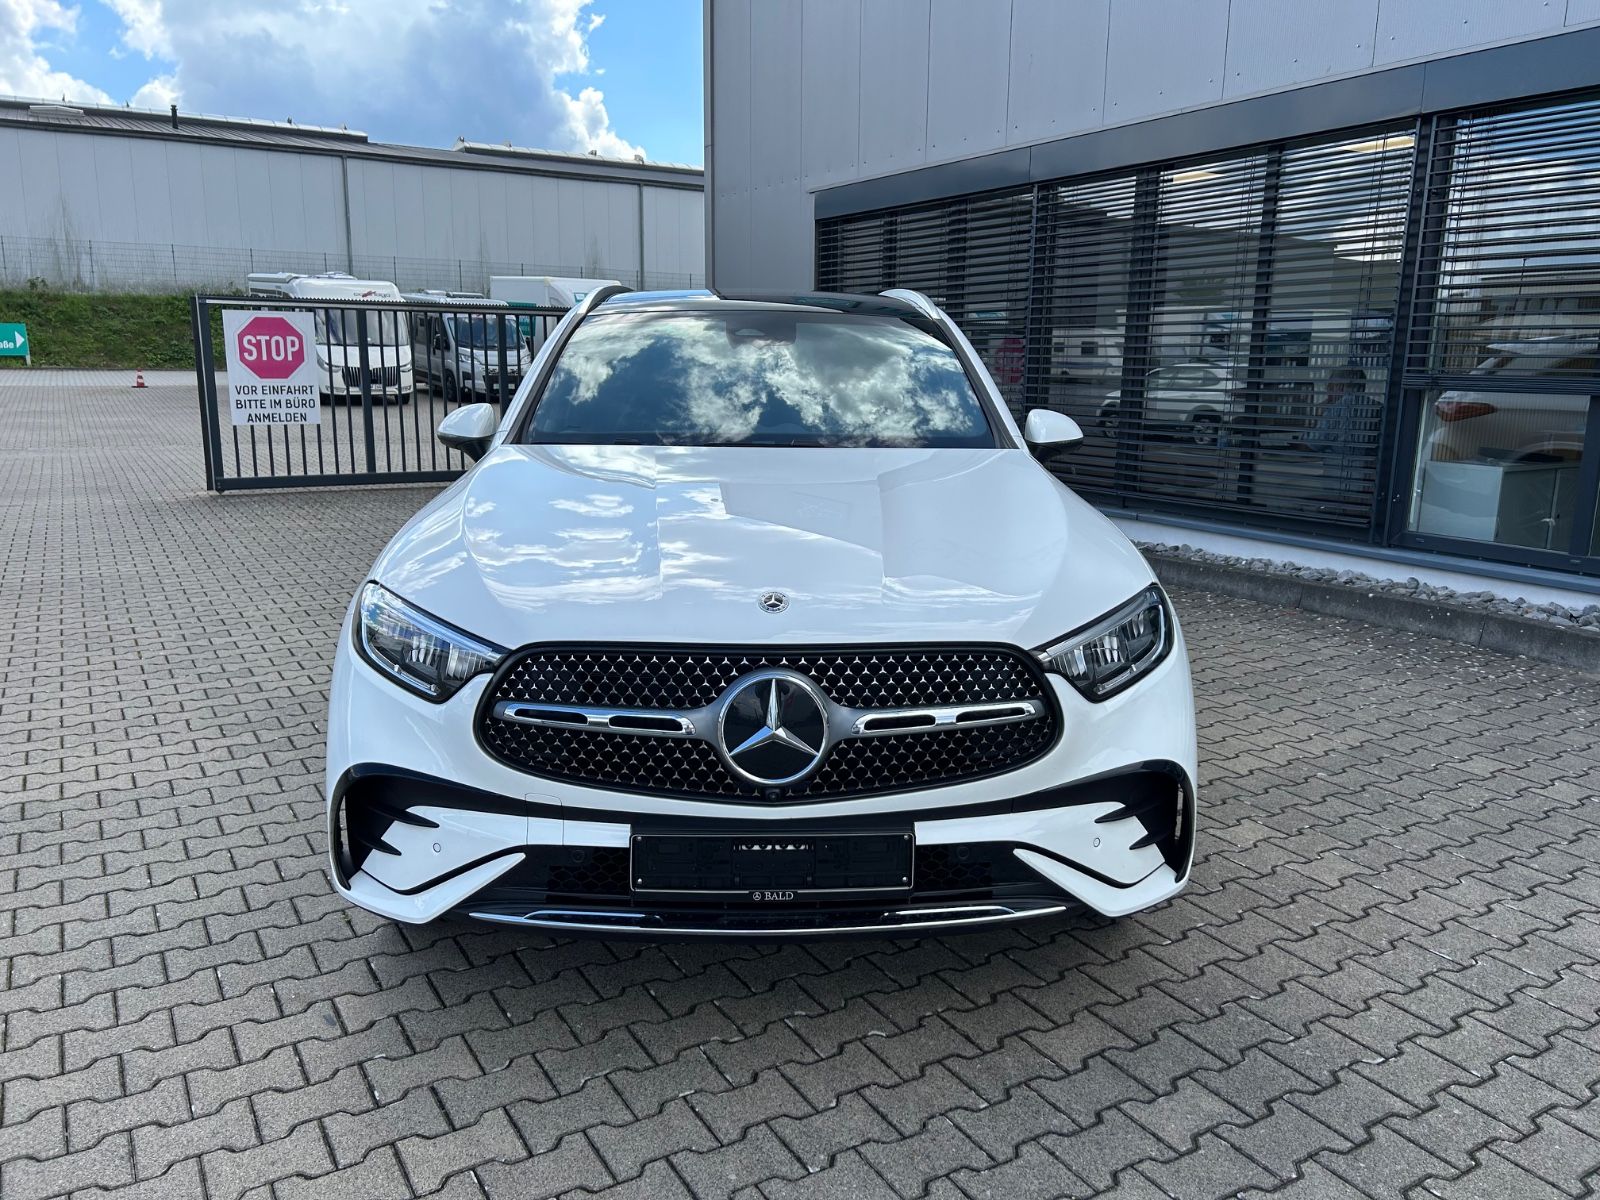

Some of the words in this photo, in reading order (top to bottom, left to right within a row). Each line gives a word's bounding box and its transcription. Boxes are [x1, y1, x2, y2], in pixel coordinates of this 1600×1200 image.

[242, 335, 300, 361] STOP
[235, 385, 258, 395] VOR
[261, 385, 314, 395] EINFAHRT
[236, 399, 267, 409] BITTE
[270, 399, 282, 409] IM
[285, 396, 316, 409] BÜRO
[247, 412, 307, 423] ANMELDEN
[764, 891, 794, 901] BALD
